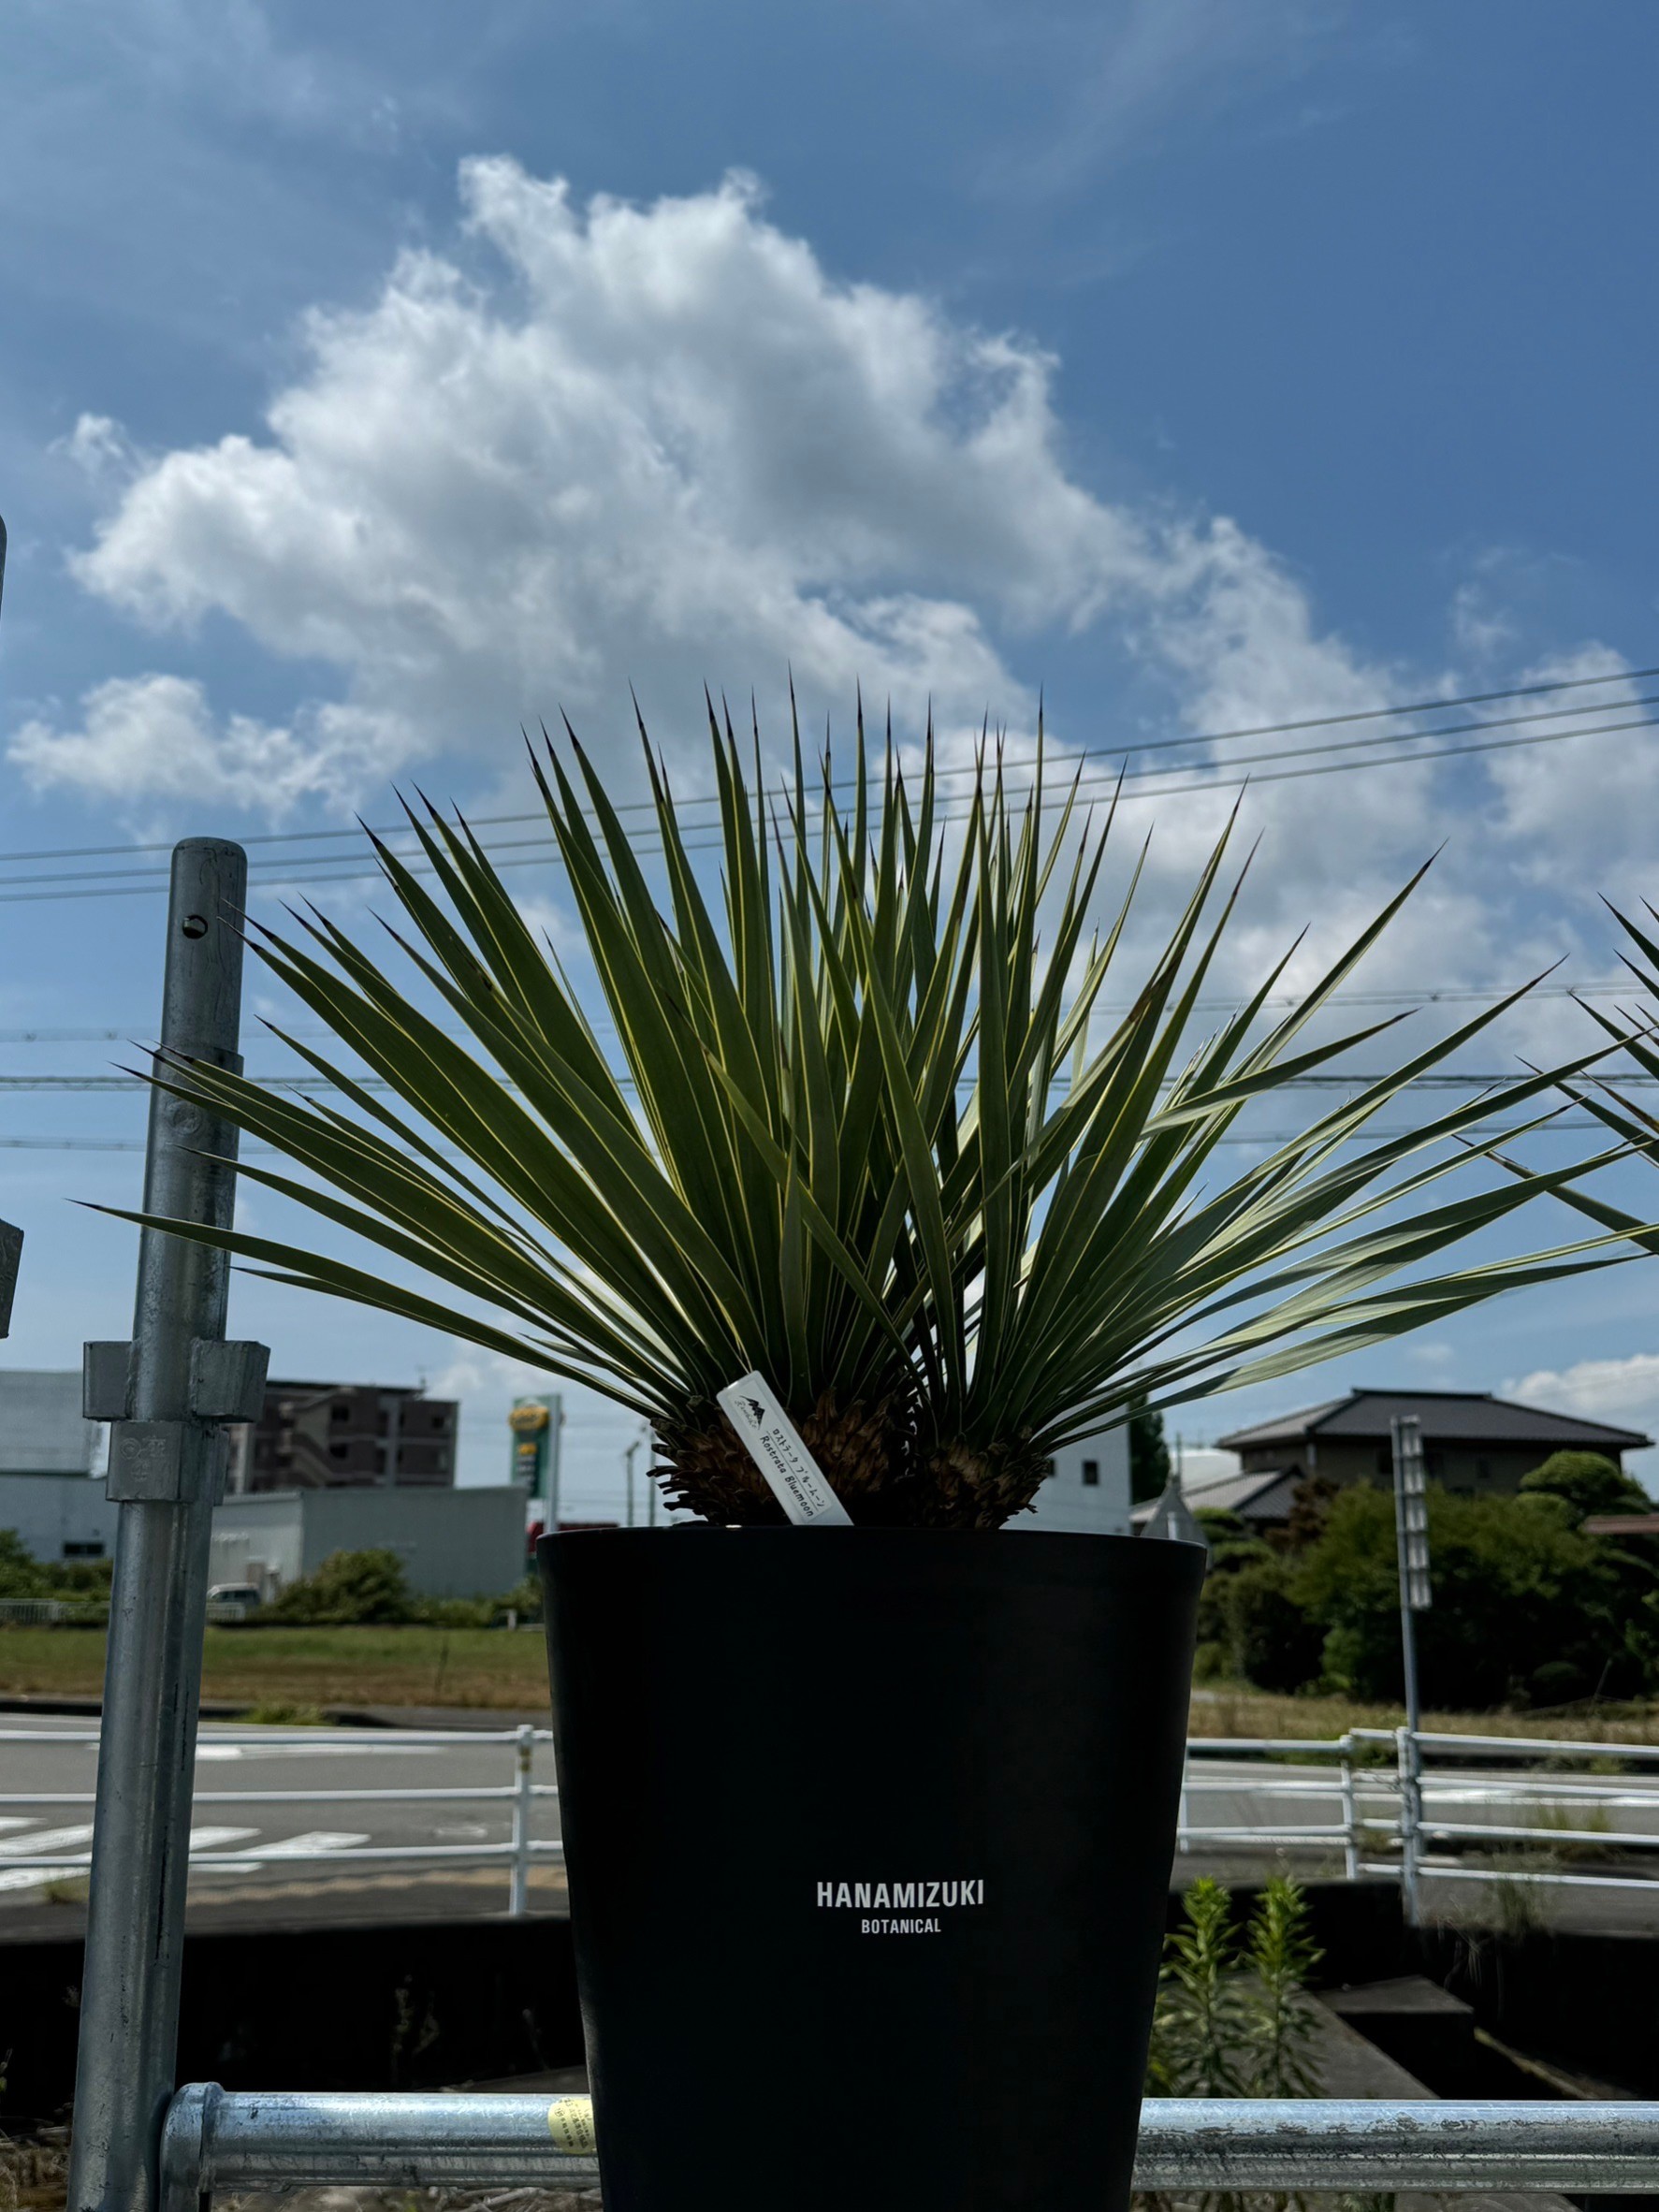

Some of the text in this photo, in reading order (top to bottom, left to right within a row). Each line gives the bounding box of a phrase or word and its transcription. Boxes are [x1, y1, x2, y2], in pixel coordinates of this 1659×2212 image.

[760, 1434, 814, 1517] Rostrata Bluemoon
[817, 1879, 983, 1908] HANAMIZUKI
[861, 1918, 941, 1934] BOTANICAL
